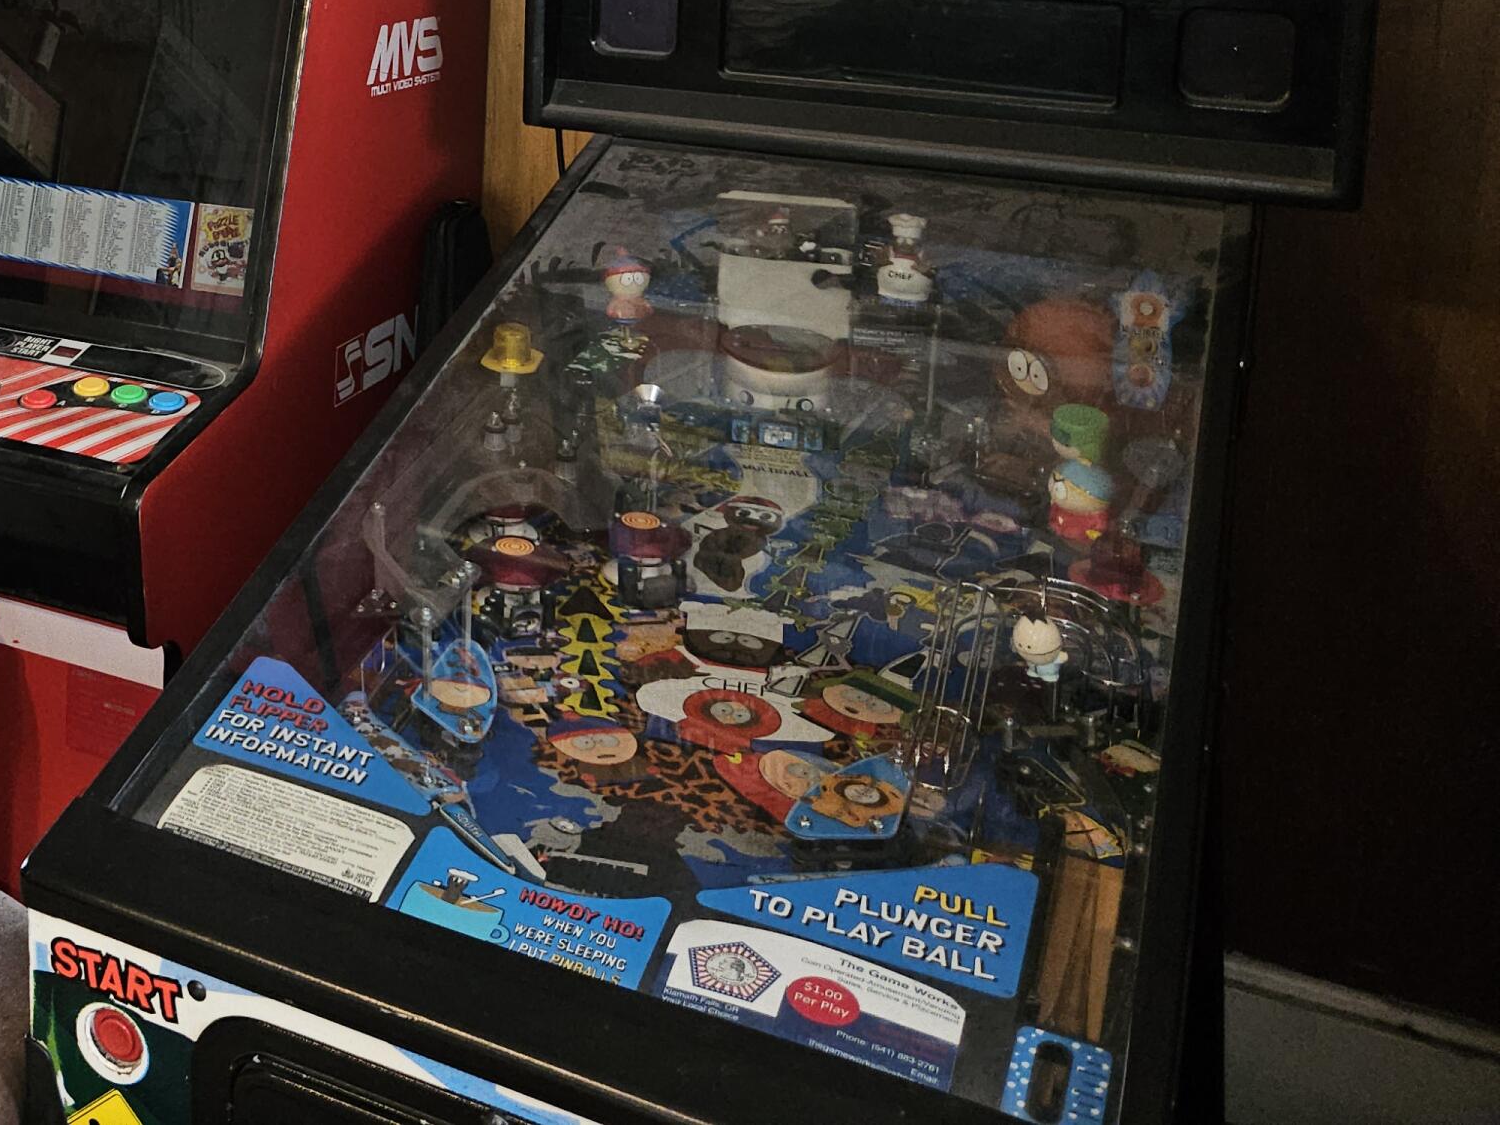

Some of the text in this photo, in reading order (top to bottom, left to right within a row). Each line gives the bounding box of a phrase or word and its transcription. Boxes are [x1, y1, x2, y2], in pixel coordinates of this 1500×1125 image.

[367, 16, 445, 86] MVS
[370, 72, 441, 98] MULTI VIDEO SYSTEM
[888, 270, 912, 281] CHEF
[11, 347, 42, 357] START
[16, 341, 50, 351] PLAYER
[24, 336, 54, 345] RIGHT
[230, 695, 329, 734] FLIPPER
[242, 680, 326, 714] HOLD
[205, 725, 368, 785] INFORMATION
[218, 710, 373, 767] FOR INSTANT
[454, 813, 482, 838] SOUTH
[520, 888, 645, 941] HOWDY HO!
[834, 888, 1004, 955] PLUNGER
[914, 885, 1009, 929] PULL
[515, 923, 627, 971] WERE SLEEPING
[543, 915, 617, 949] WHEN YOU
[750, 889, 998, 982] TO PLAY BALL
[516, 944, 548, 961] PUT
[51, 937, 183, 1024] START
[803, 981, 843, 1001] $1.00
[838, 957, 959, 1010] The Game Works
[794, 991, 850, 1019] Per Play
